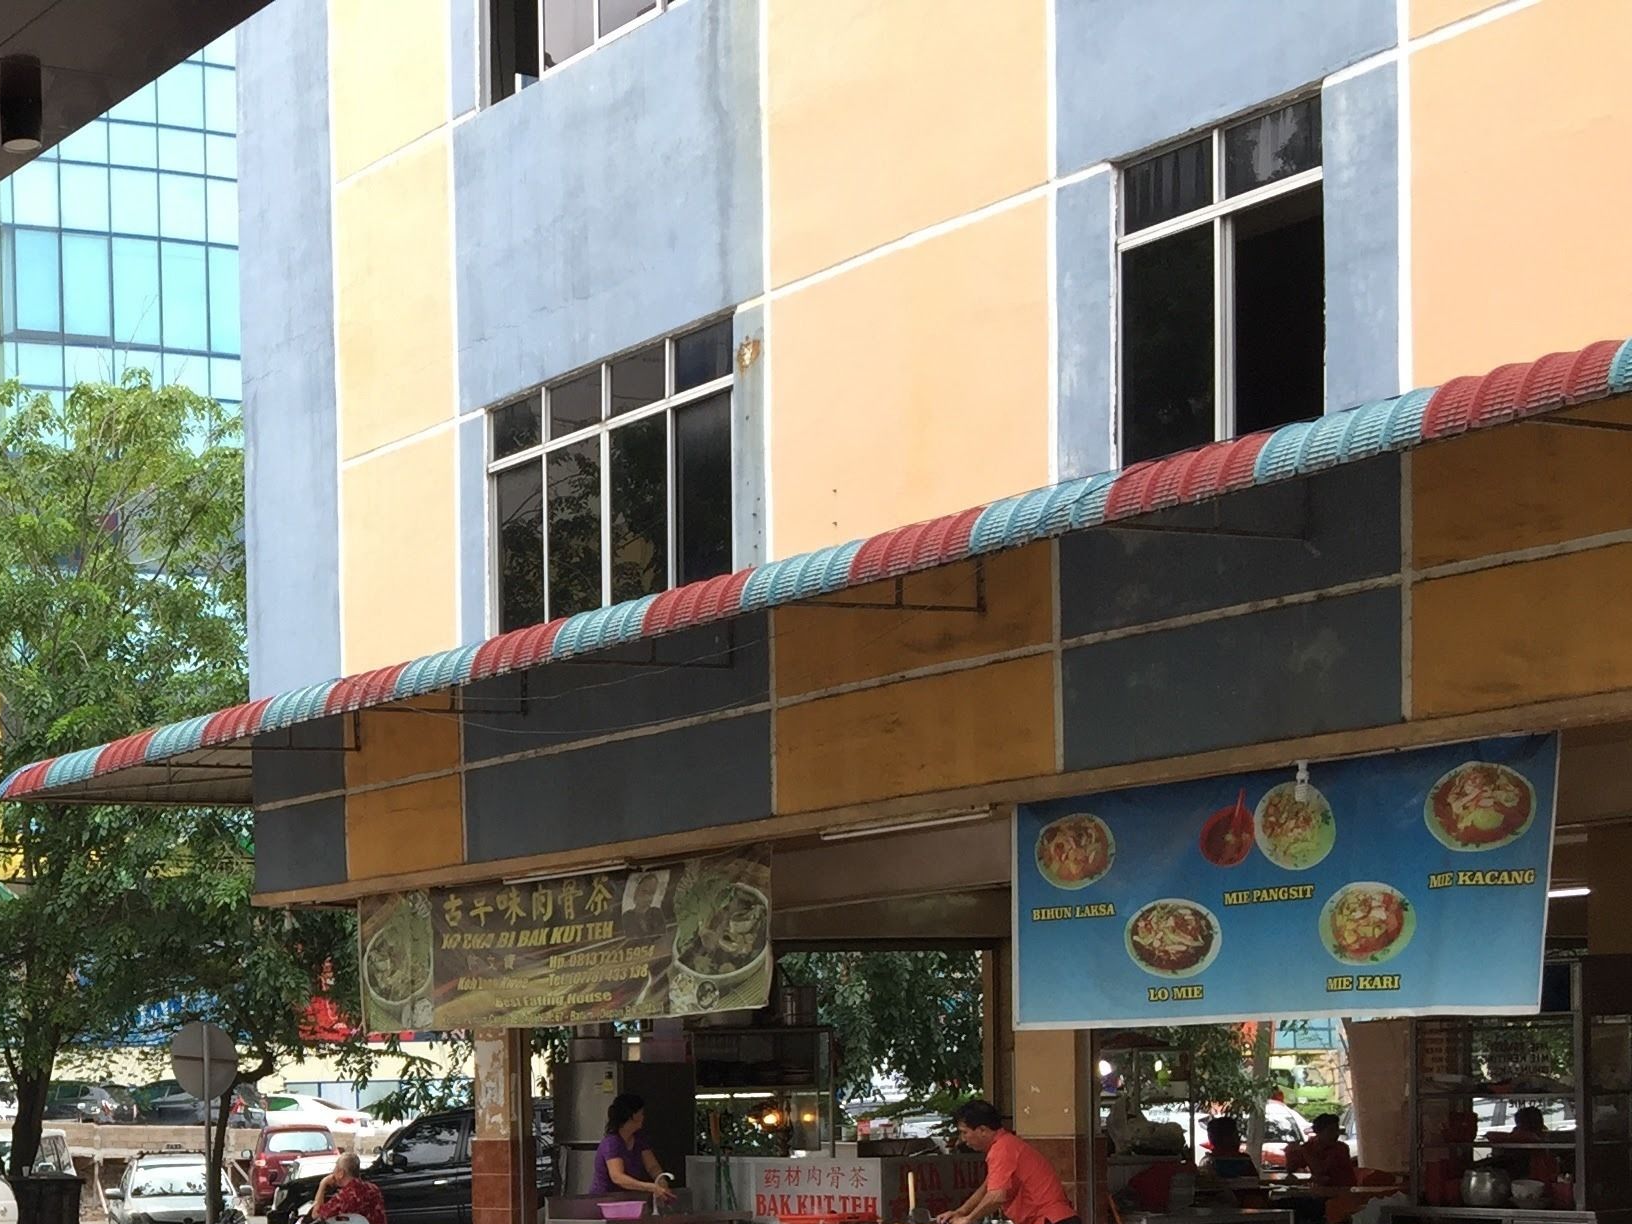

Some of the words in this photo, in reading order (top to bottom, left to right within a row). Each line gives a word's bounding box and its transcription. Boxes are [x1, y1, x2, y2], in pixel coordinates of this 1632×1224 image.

[1429, 872, 1454, 888] MIE
[1458, 869, 1535, 885] KACANG
[1224, 890, 1251, 905] MIE
[1253, 884, 1314, 902] PANGSIT
[1032, 906, 1072, 921] BIHUN
[1075, 902, 1116, 918] LAKSA
[516, 927, 548, 947] BAK
[549, 923, 585, 945] KUT
[586, 920, 615, 940] TEH
[1326, 976, 1353, 991] MIE
[1357, 975, 1401, 990] KARI
[567, 989, 613, 1006] House
[1148, 986, 1169, 1002] LO
[1171, 985, 1204, 1001] MIE
[764, 1165, 869, 1189] 药材肉骨茶
[755, 1194, 792, 1217] BAK
[794, 1195, 835, 1216] KUT
[838, 1196, 878, 1216] TEH
